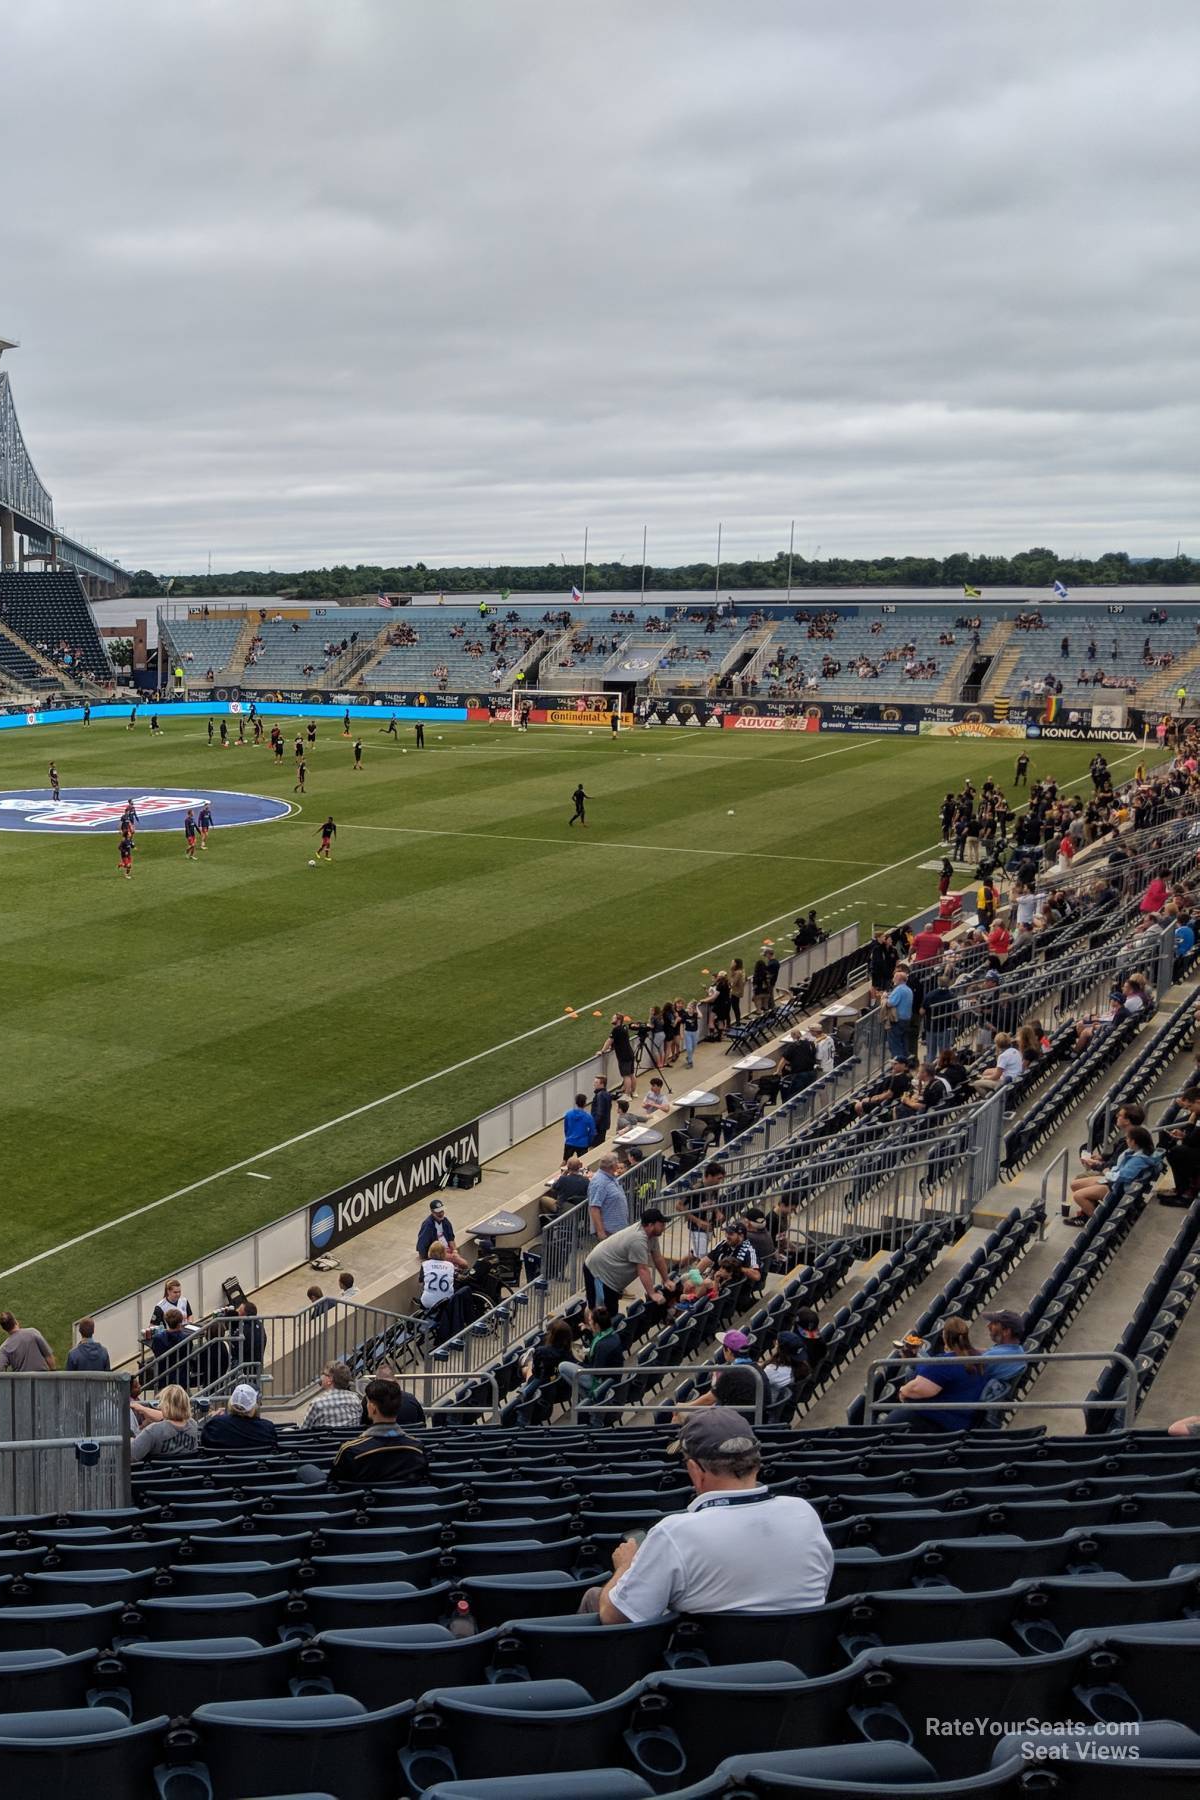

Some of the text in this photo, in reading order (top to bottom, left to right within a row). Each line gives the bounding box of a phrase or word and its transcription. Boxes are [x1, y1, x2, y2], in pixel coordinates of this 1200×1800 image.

[882, 605, 895, 613] 138
[1109, 605, 1123, 614] 139
[550, 711, 600, 722] Continental
[1042, 727, 1137, 741] KONICA MINOLTA
[338, 1133, 479, 1232] KONICA MINOLTA
[428, 1271, 449, 1292] 26
